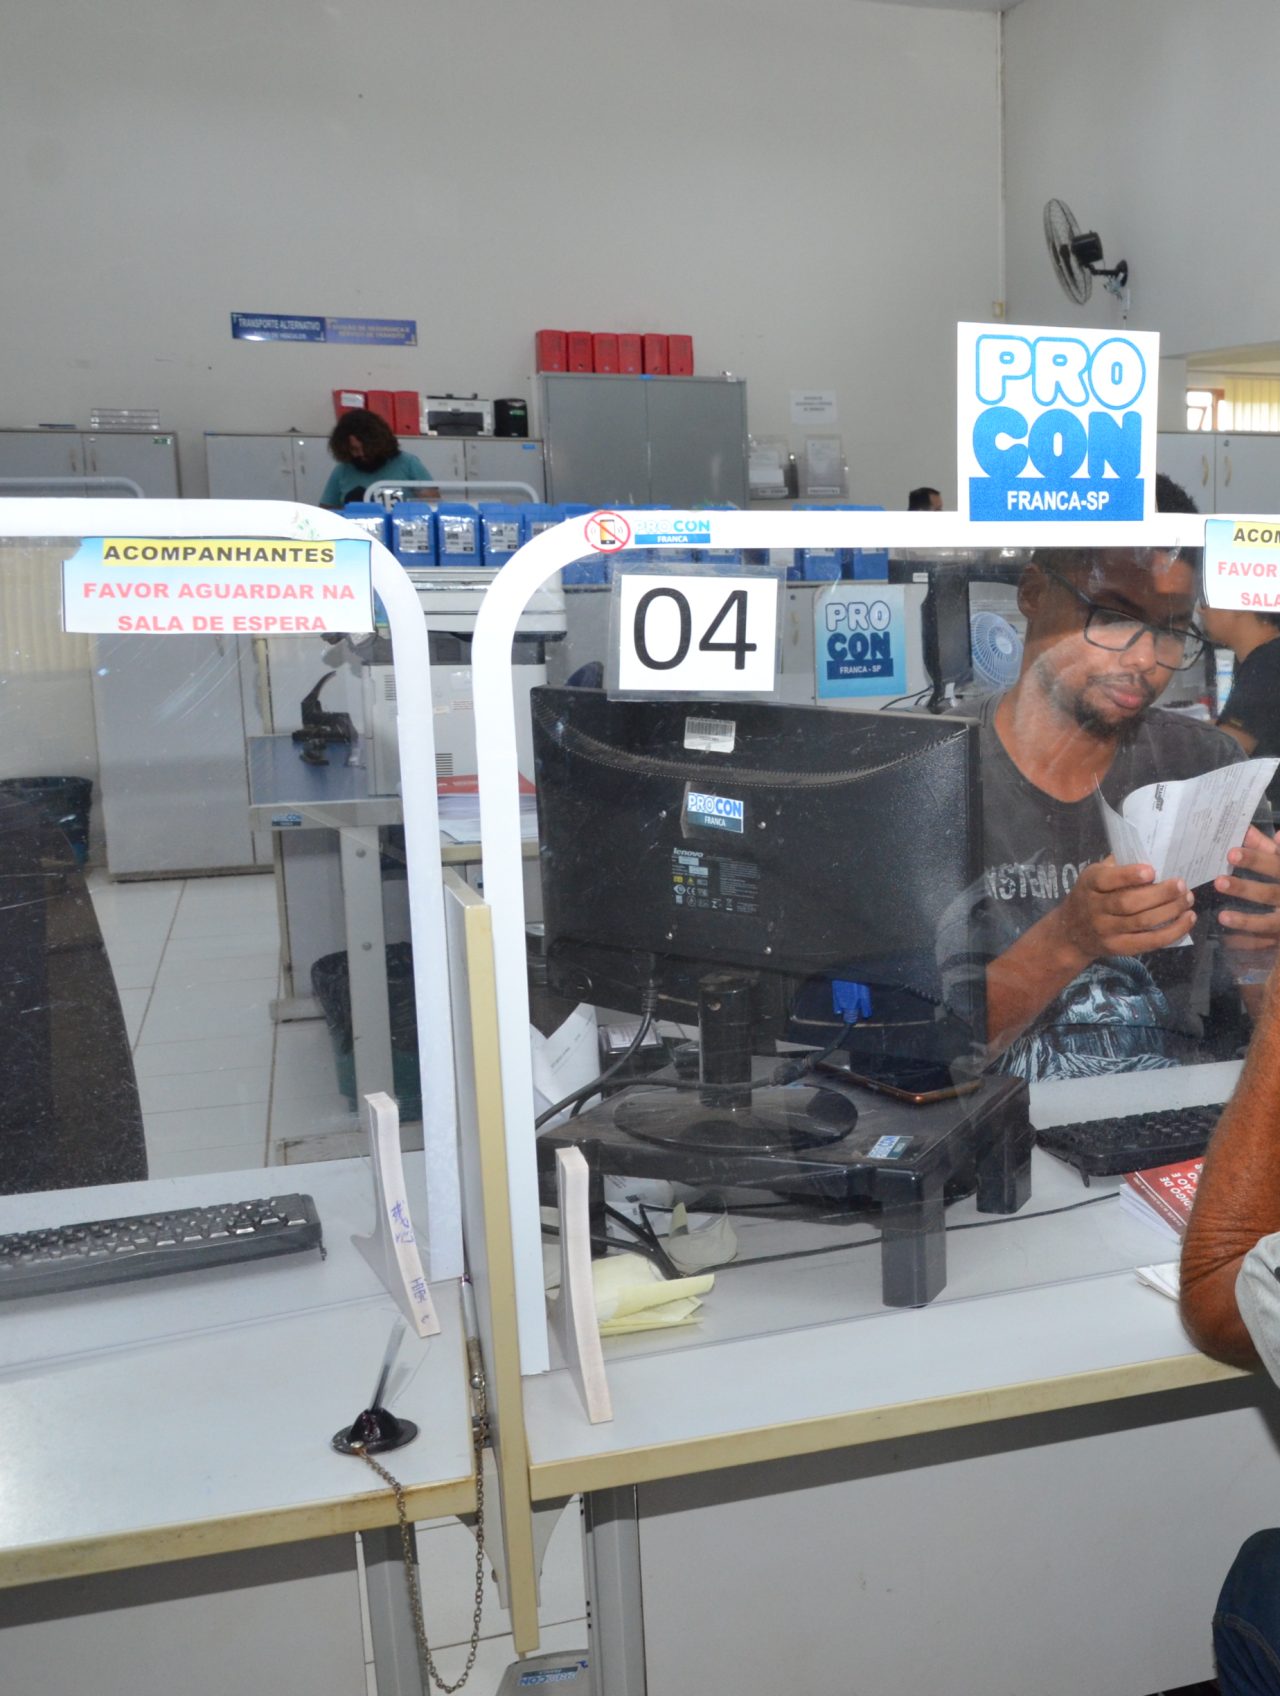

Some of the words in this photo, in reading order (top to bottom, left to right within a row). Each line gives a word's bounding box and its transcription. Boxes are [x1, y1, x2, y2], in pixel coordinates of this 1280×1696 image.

[239, 318, 279, 329] TRANSPORTE
[280, 320, 321, 331] ALTERNATIVO
[976, 334, 1146, 410] PRO
[972, 406, 1142, 479] CON
[1007, 490, 1110, 511] FRANCA-SP
[657, 535, 689, 543] FRANCA
[103, 546, 335, 563] ACOMPANHANTES
[1217, 561, 1277, 577] FAVOR
[83, 583, 169, 599] FAVOR
[178, 583, 314, 599] AGUARDAR
[323, 585, 355, 600] NA
[118, 615, 183, 632] SALA
[193, 616, 225, 632] DE
[233, 616, 327, 632] ESPERA
[825, 600, 891, 632] PRO
[633, 587, 758, 671] 04
[827, 631, 891, 660] CON
[840, 665, 867, 674] FRANCA
[872, 664, 882, 673] SP
[688, 794, 742, 818] PROCON
[704, 815, 726, 828] FRANCA
[673, 847, 704, 858] lenovo
